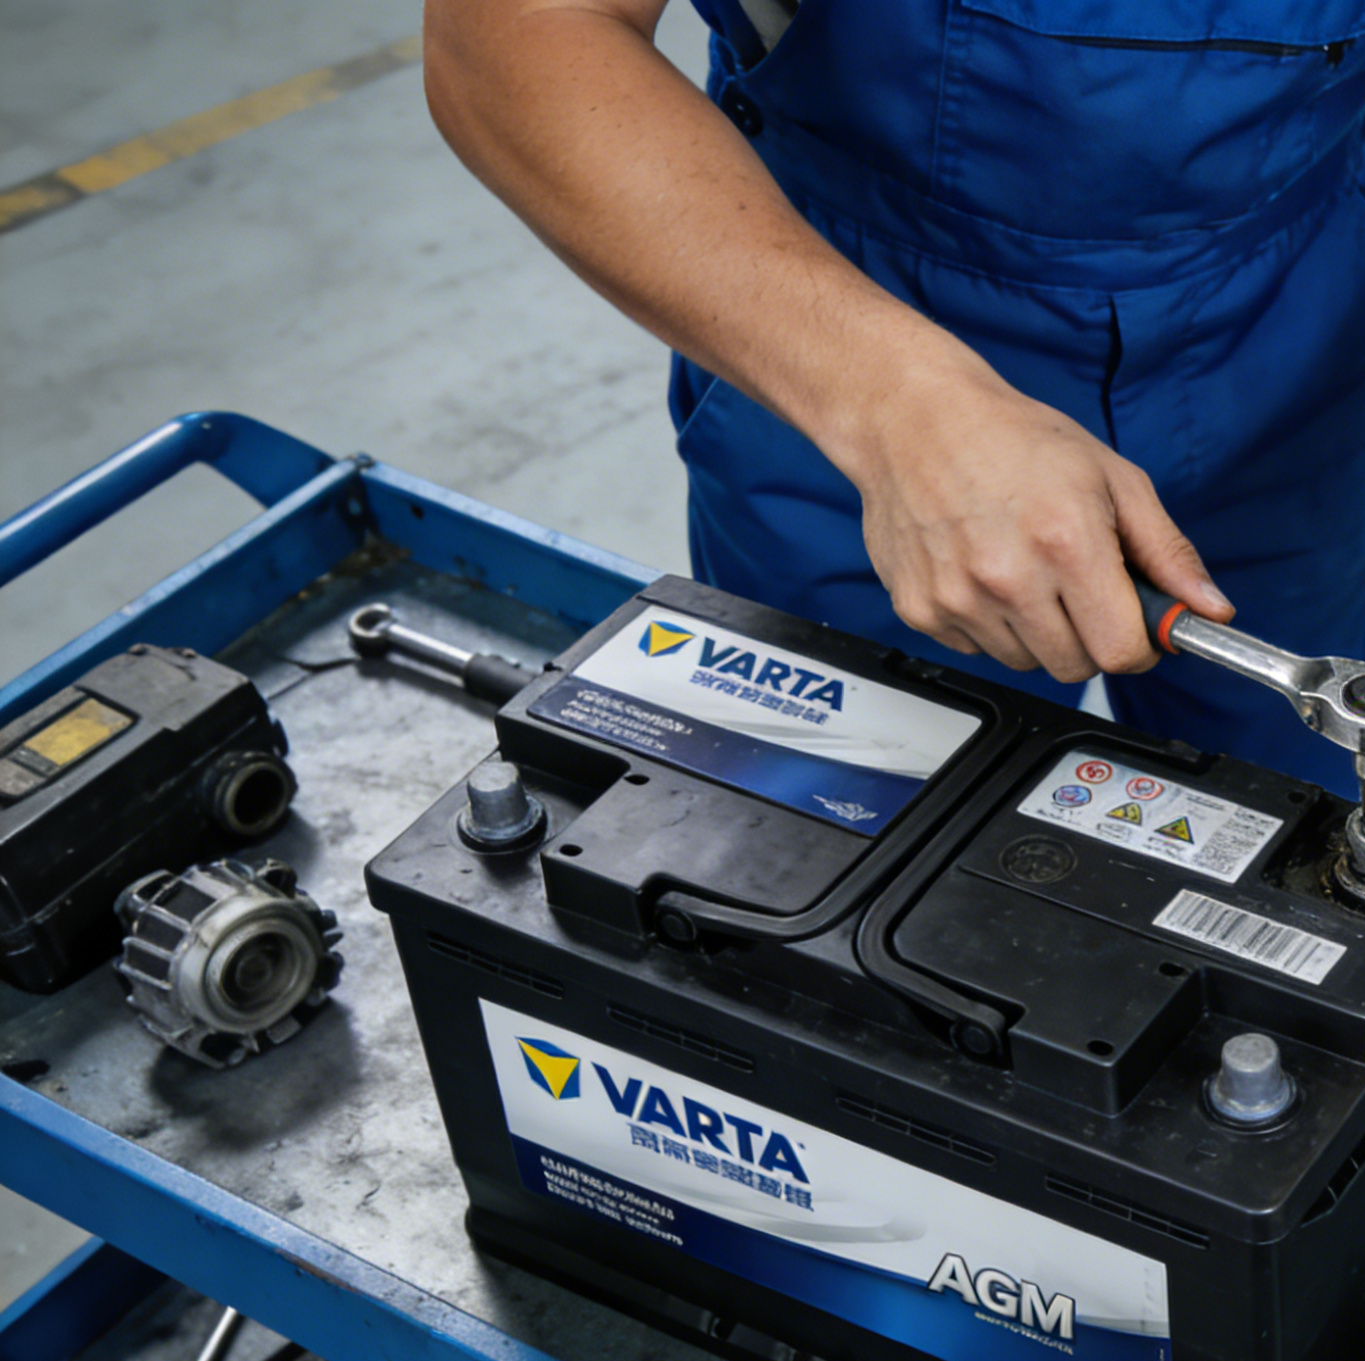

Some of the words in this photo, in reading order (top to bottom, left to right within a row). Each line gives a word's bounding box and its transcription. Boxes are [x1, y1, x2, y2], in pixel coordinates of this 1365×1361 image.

[698, 636, 845, 712] VARTA
[590, 1060, 811, 1185] VARTA
[927, 1252, 1076, 1341] AGM
